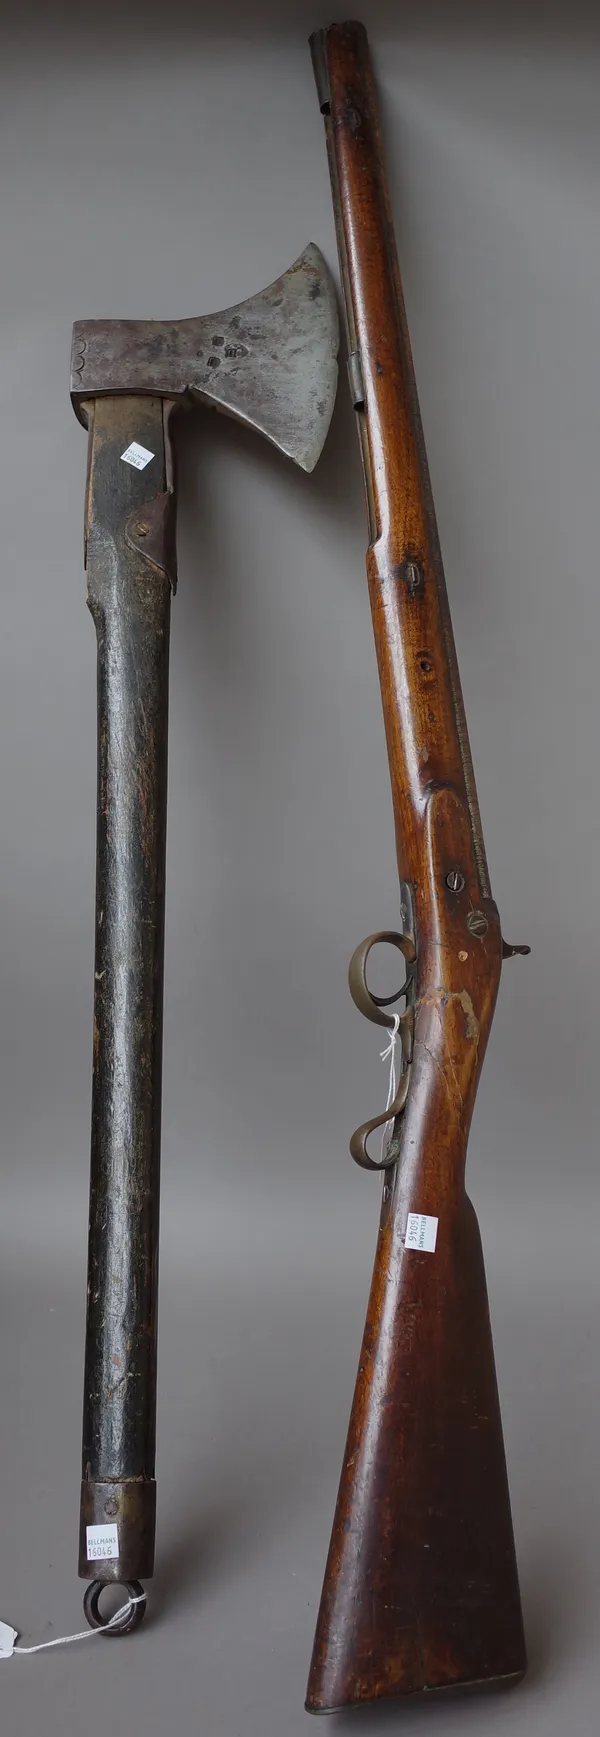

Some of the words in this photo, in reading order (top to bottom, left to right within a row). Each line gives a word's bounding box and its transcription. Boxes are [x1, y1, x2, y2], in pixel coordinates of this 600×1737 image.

[408, 1215, 419, 1242] 16046
[418, 1216, 427, 1248] BELLMANS
[88, 1537, 116, 1545] BELLMANS
[88, 1546, 112, 1557] 16046
